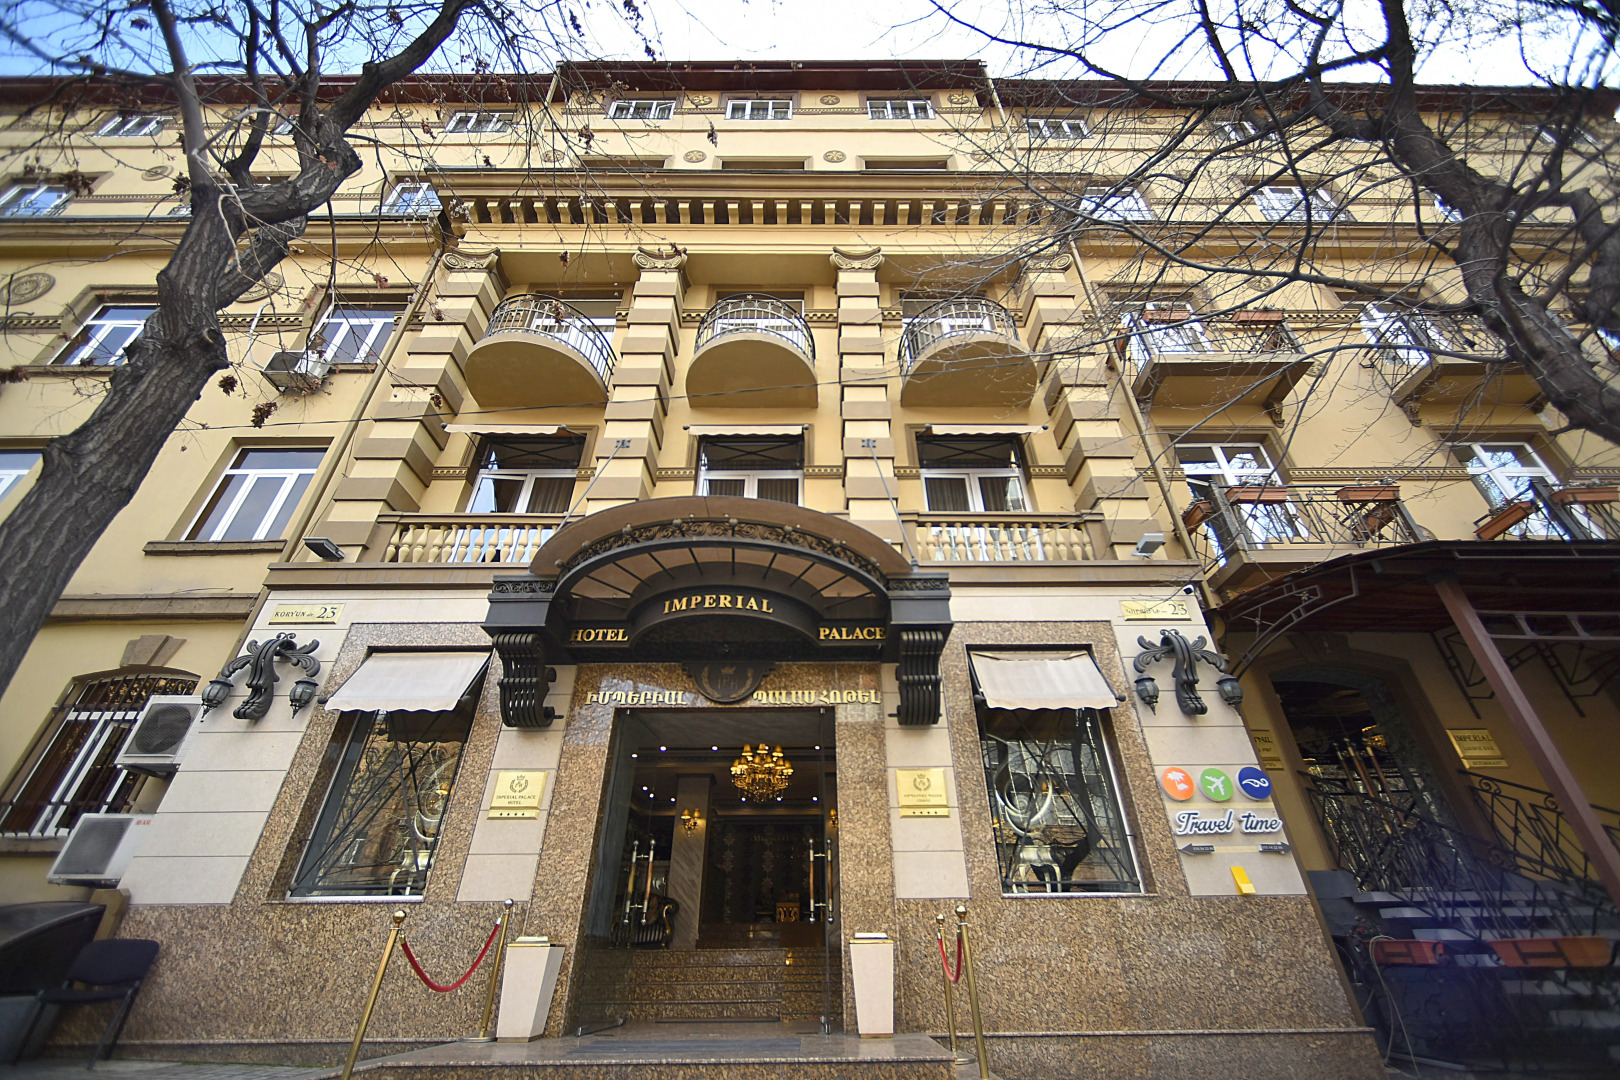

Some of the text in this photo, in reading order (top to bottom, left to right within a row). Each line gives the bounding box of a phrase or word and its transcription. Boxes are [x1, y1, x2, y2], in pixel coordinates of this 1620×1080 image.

[663, 594, 774, 614] IMPERIAL
[1168, 603, 1188, 616] 23
[316, 606, 337, 619] 23
[569, 628, 629, 642] HOTEL
[818, 626, 886, 640] PALACE
[584, 689, 882, 706] ԻՄՊԵՐԻԱԼ ՊԱԼԱՍ ՀՈԹԵԼ
[1176, 809, 1282, 834] Travel time
